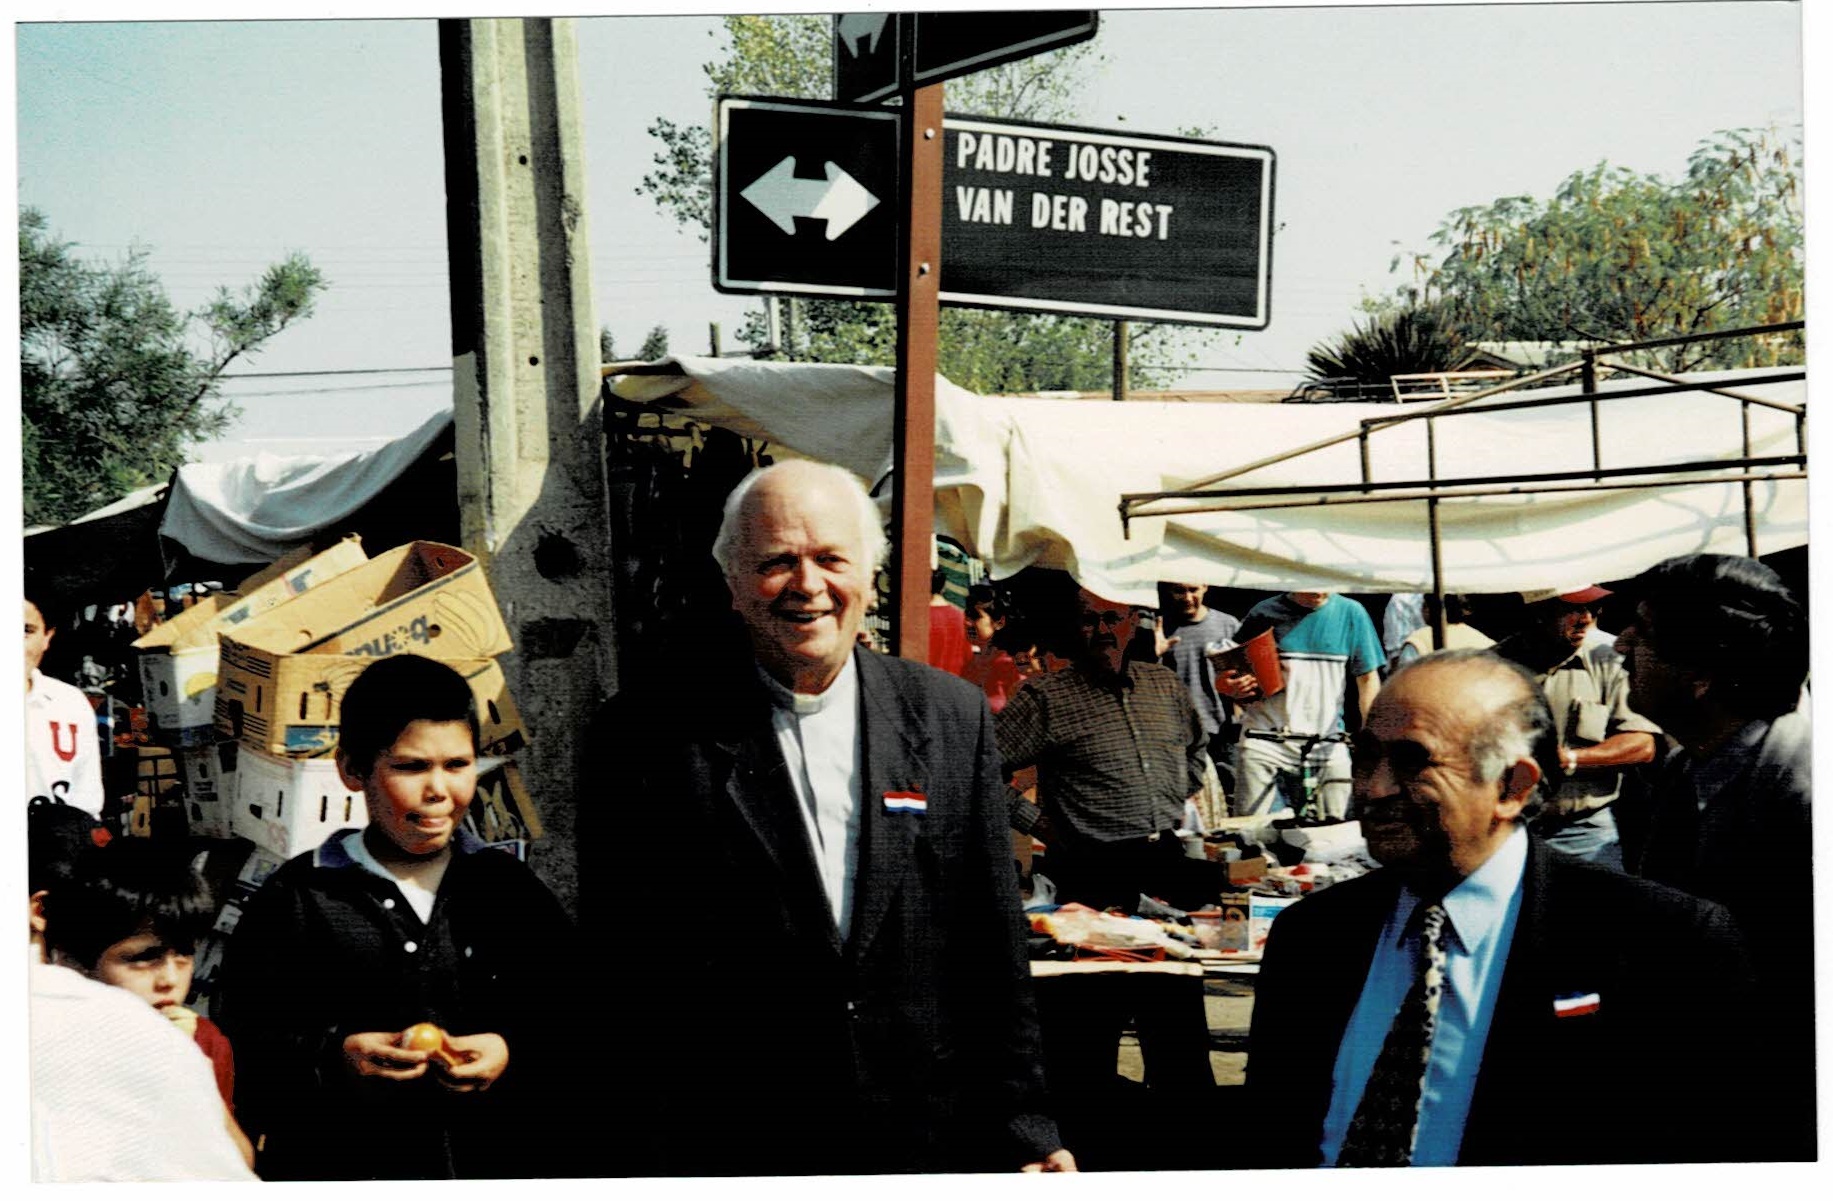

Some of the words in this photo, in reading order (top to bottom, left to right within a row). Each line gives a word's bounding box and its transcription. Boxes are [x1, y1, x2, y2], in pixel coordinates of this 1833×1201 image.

[957, 131, 1053, 177] PADRE
[1064, 143, 1152, 187] JOSSE
[955, 185, 1014, 225] VAN
[1031, 192, 1089, 232] DER
[1100, 198, 1174, 240] REST
[49, 721, 79, 763] U
